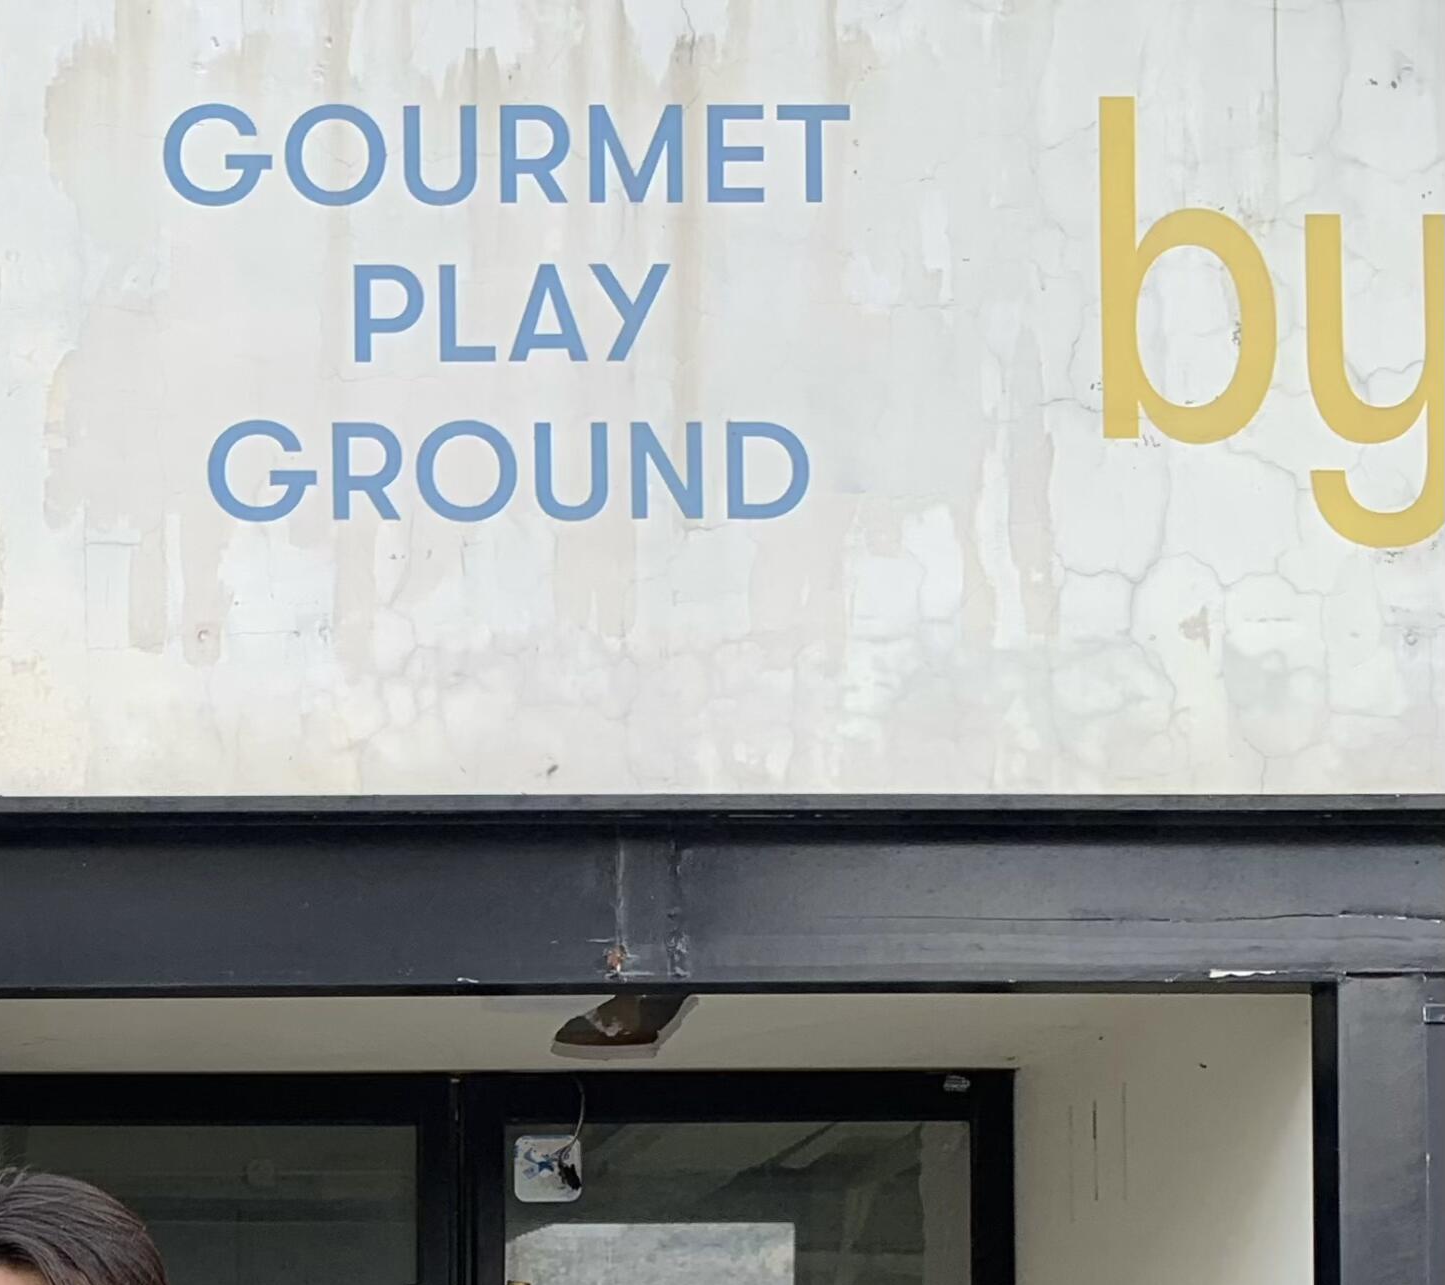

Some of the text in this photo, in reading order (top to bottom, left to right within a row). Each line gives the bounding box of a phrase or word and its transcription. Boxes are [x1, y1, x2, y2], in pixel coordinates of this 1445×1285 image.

[163, 103, 851, 207] GOURMET
[353, 263, 670, 363] PLAY
[1099, 96, 1445, 549] by
[207, 420, 811, 522] GROUND
